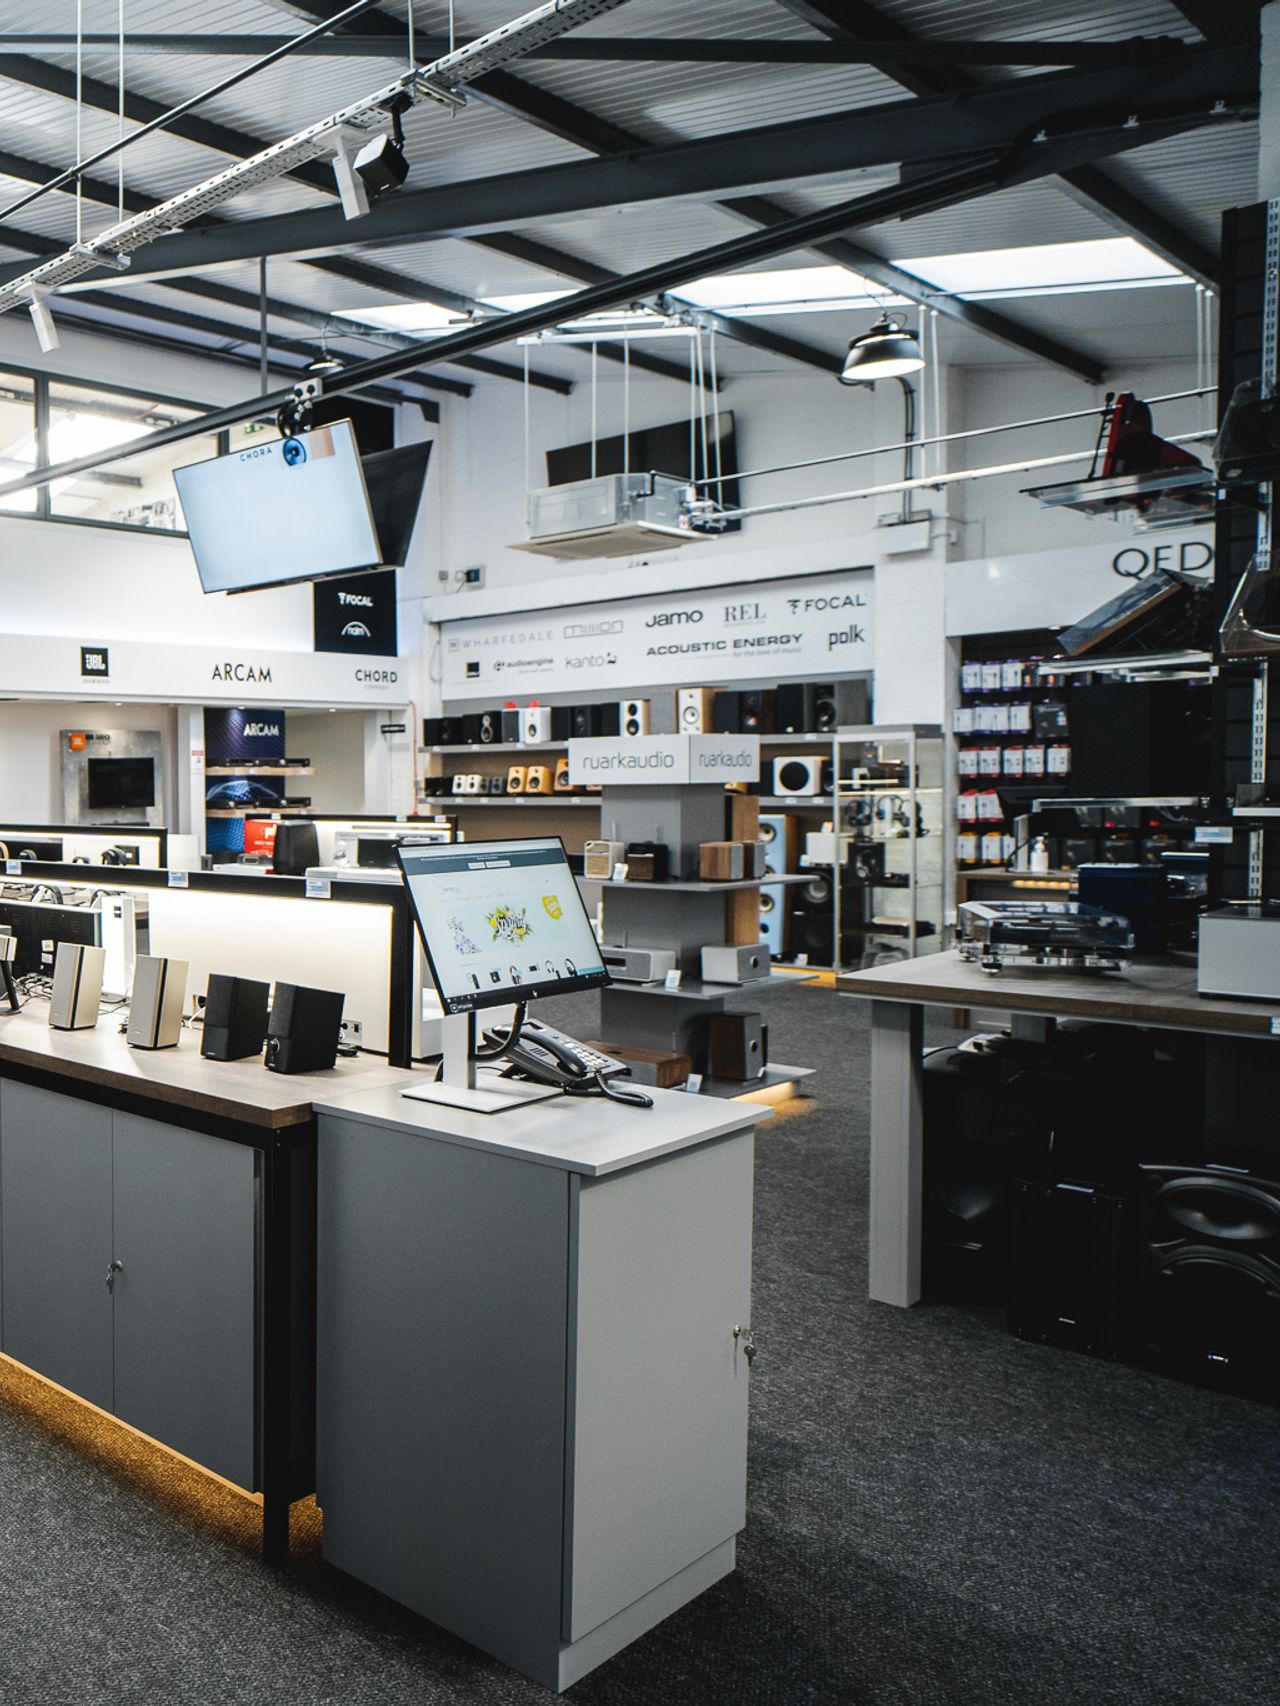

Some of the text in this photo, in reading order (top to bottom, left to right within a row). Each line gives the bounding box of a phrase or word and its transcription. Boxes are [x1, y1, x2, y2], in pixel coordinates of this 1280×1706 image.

[240, 447, 272, 462] CHORA
[346, 594, 374, 607] FOCAL
[805, 594, 867, 612] FOCAL
[645, 610, 703, 628] Jamo
[724, 603, 767, 622] REL
[462, 631, 554, 648] WHARFEDALE
[646, 633, 804, 656] ACOUSTIC ENERGY
[829, 624, 865, 651] polk
[85, 653, 106, 670] JBL
[506, 657, 554, 669] audioengine
[566, 654, 606, 670] kanto
[212, 663, 272, 683] ARCAM
[355, 669, 398, 683] CHORD
[243, 722, 279, 737] ARCAM
[583, 750, 674, 770] ruarkaudio
[699, 750, 752, 768] ruarkaudio
